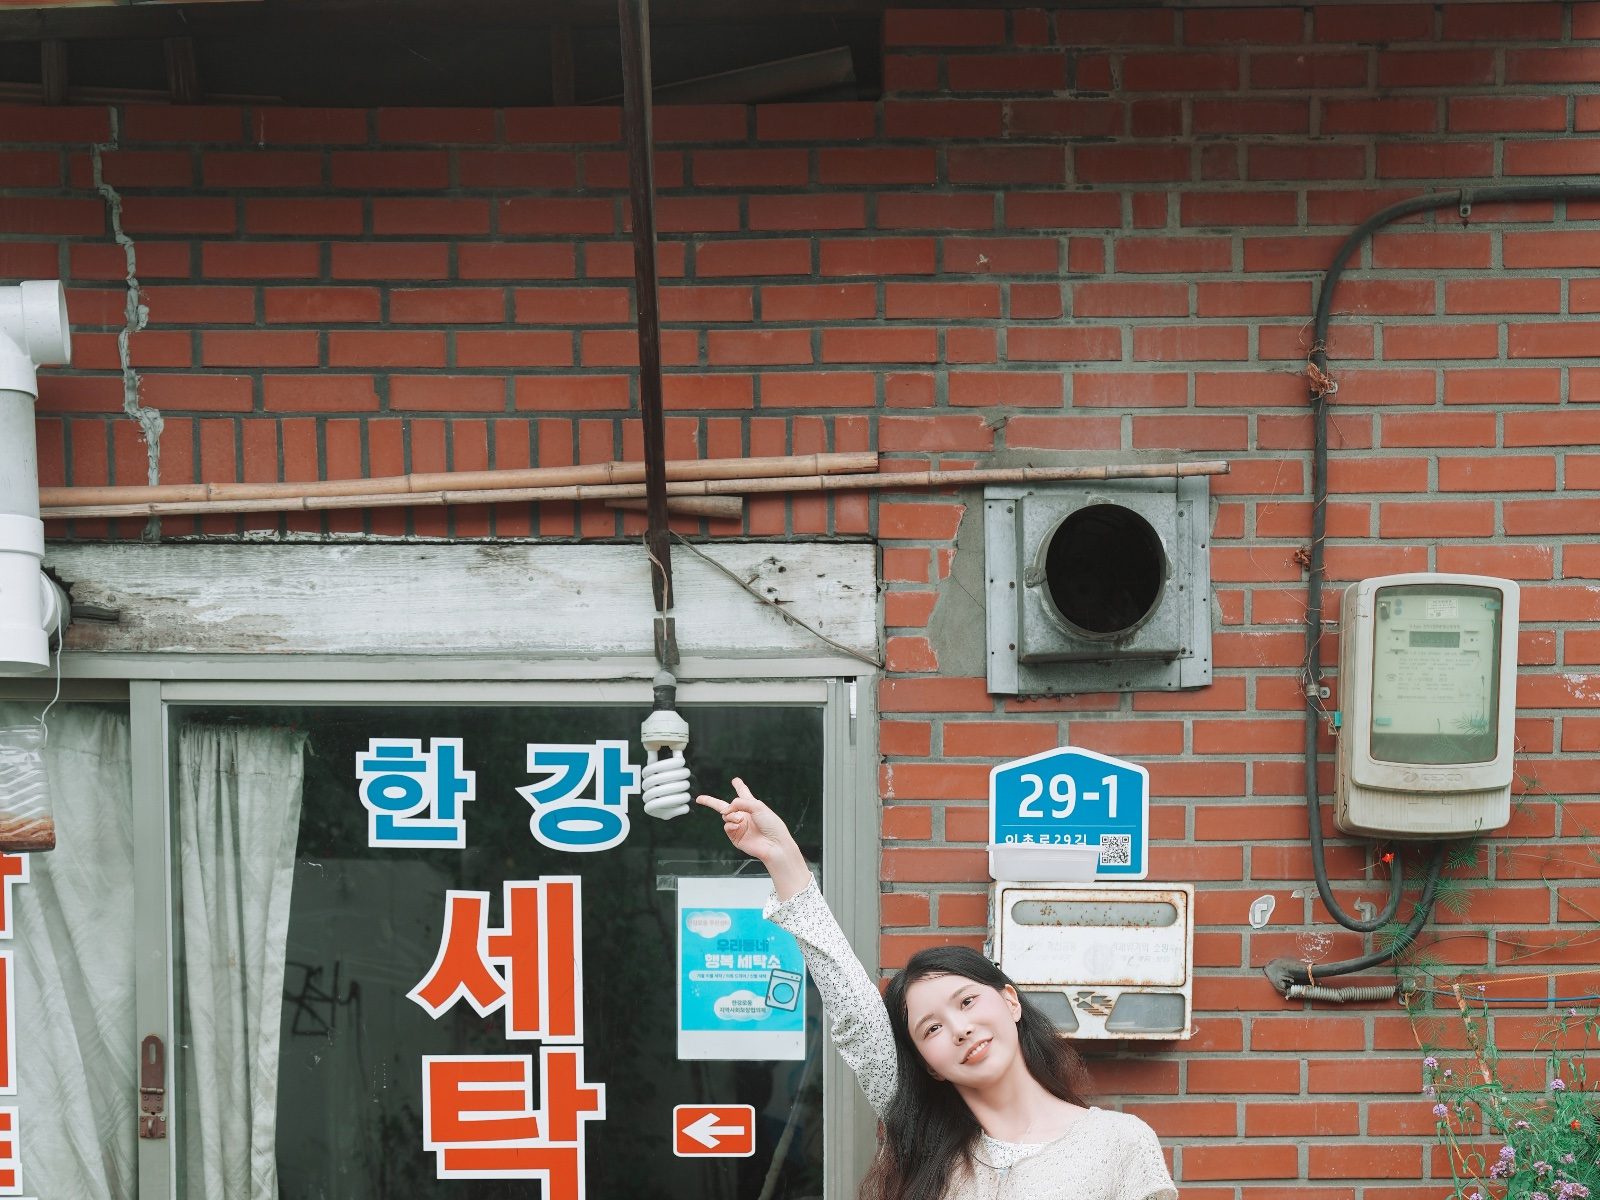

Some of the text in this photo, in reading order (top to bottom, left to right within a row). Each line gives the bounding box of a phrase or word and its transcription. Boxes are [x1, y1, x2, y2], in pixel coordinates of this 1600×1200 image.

[356, 738, 643, 852] 한강
[1018, 773, 1119, 819] 29-1
[717, 938, 770, 952] 우리동네
[705, 953, 781, 969] 행복 세탁소
